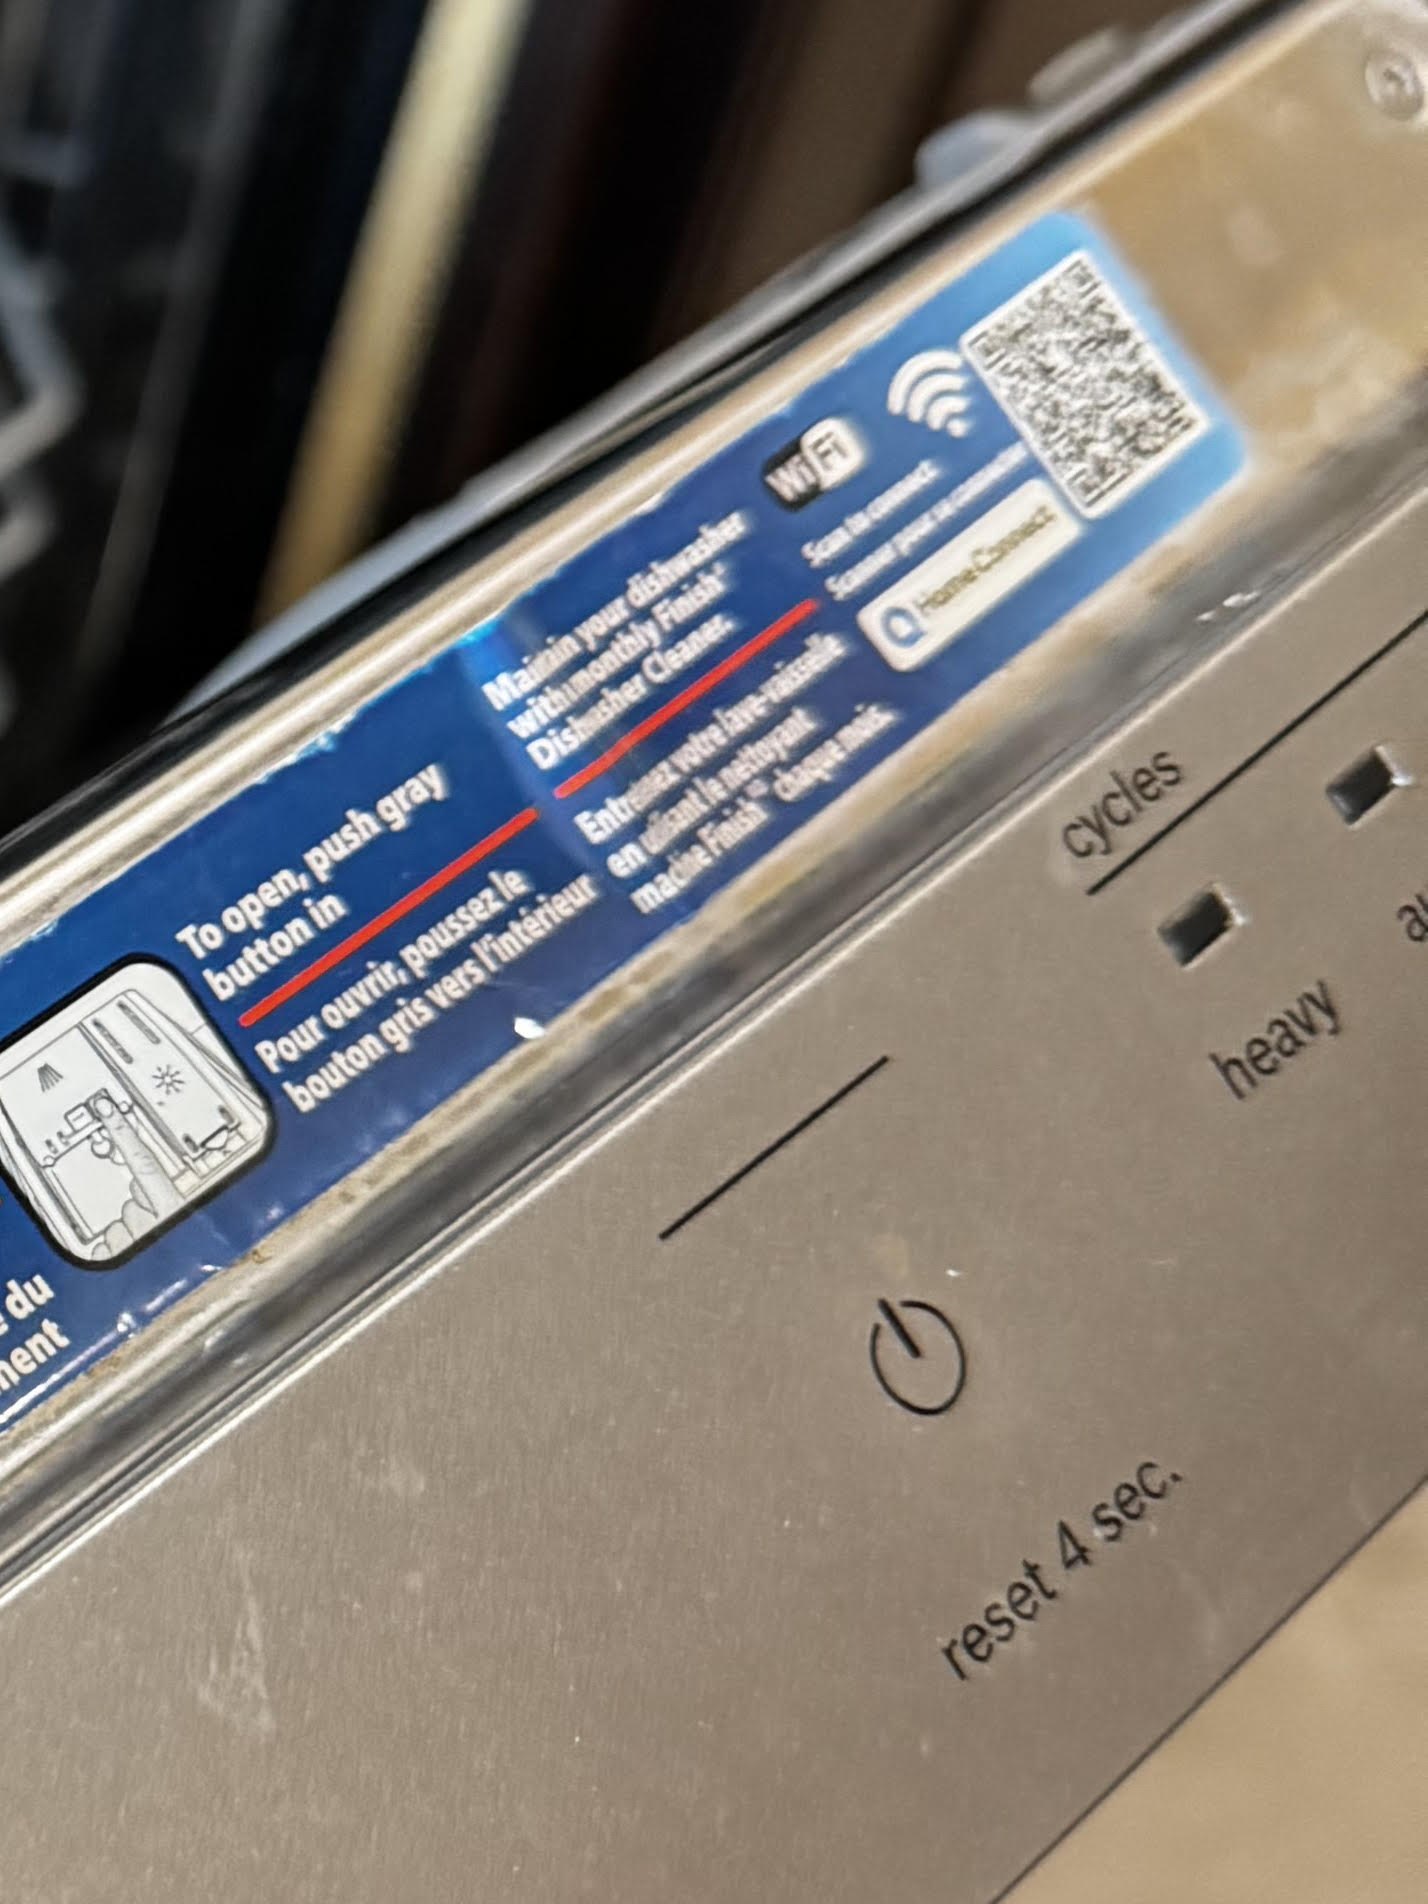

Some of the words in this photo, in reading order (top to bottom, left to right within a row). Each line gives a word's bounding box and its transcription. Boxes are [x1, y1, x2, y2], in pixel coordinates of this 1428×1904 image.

[574, 597, 630, 651] your
[626, 512, 748, 608] dishwasher
[564, 616, 661, 694] monthly
[175, 924, 223, 959] To
[221, 868, 311, 933] open,
[303, 807, 383, 883] push
[376, 763, 446, 831] gray
[606, 841, 647, 877] en
[1062, 751, 1183, 859] cycles
[202, 918, 314, 1001] button
[303, 895, 348, 929] in
[255, 1016, 326, 1073] Pour
[321, 961, 409, 1030] ouvrir,
[399, 887, 500, 977] poussez
[488, 869, 531, 911] le
[282, 1033, 384, 1113] bouton
[380, 998, 434, 1052] gris
[426, 960, 485, 1010] vers
[1209, 980, 1342, 1101] heavy
[5, 1274, 55, 1319] du
[942, 1559, 1058, 1681] reset
[1057, 1519, 1092, 1570] 4
[1091, 1461, 1183, 1542] sec.
